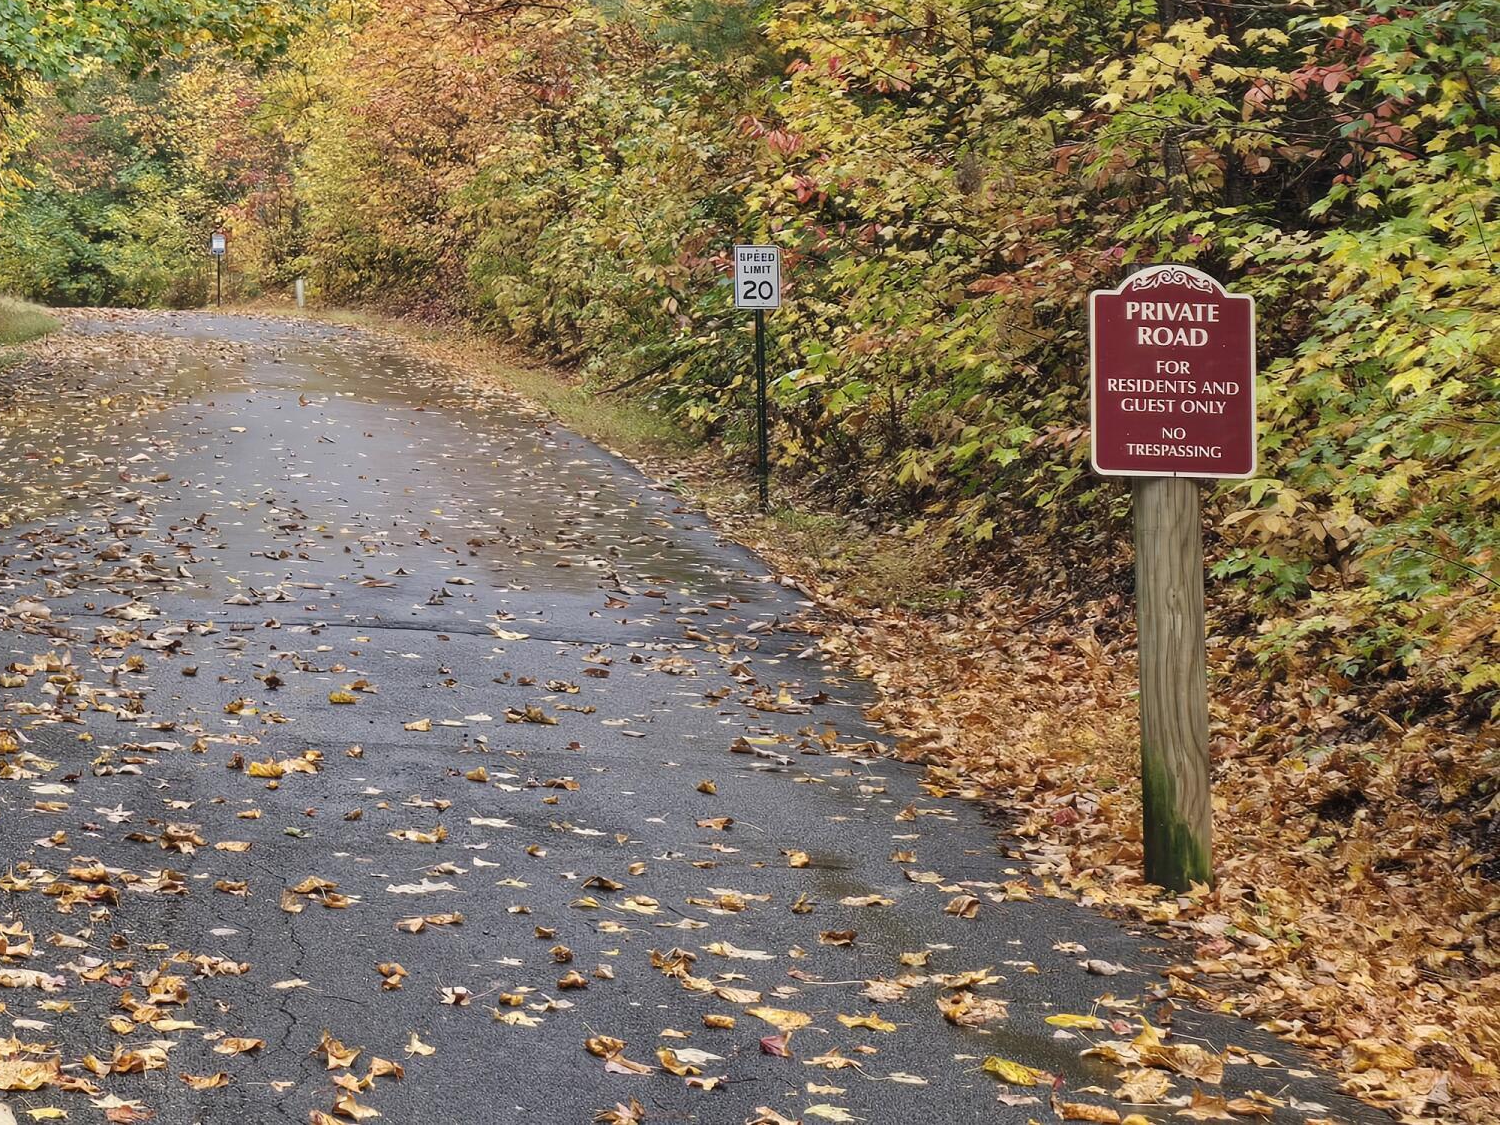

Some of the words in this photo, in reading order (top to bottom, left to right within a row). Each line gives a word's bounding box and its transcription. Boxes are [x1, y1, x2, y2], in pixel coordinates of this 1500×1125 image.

[740, 253, 775, 261] SPEED
[743, 265, 771, 273] LIMIT
[743, 280, 773, 300] 20
[1126, 301, 1220, 323] PRIVATE
[1137, 326, 1209, 347] ROAD
[1156, 360, 1190, 375] FOR
[1107, 378, 1197, 395] RESIDENTS
[1201, 381, 1240, 396] AND
[1121, 398, 1176, 413] GUEST
[1180, 399, 1227, 414] ONLY
[1161, 427, 1186, 440] NO
[1126, 443, 1222, 458] TRESPASSING
